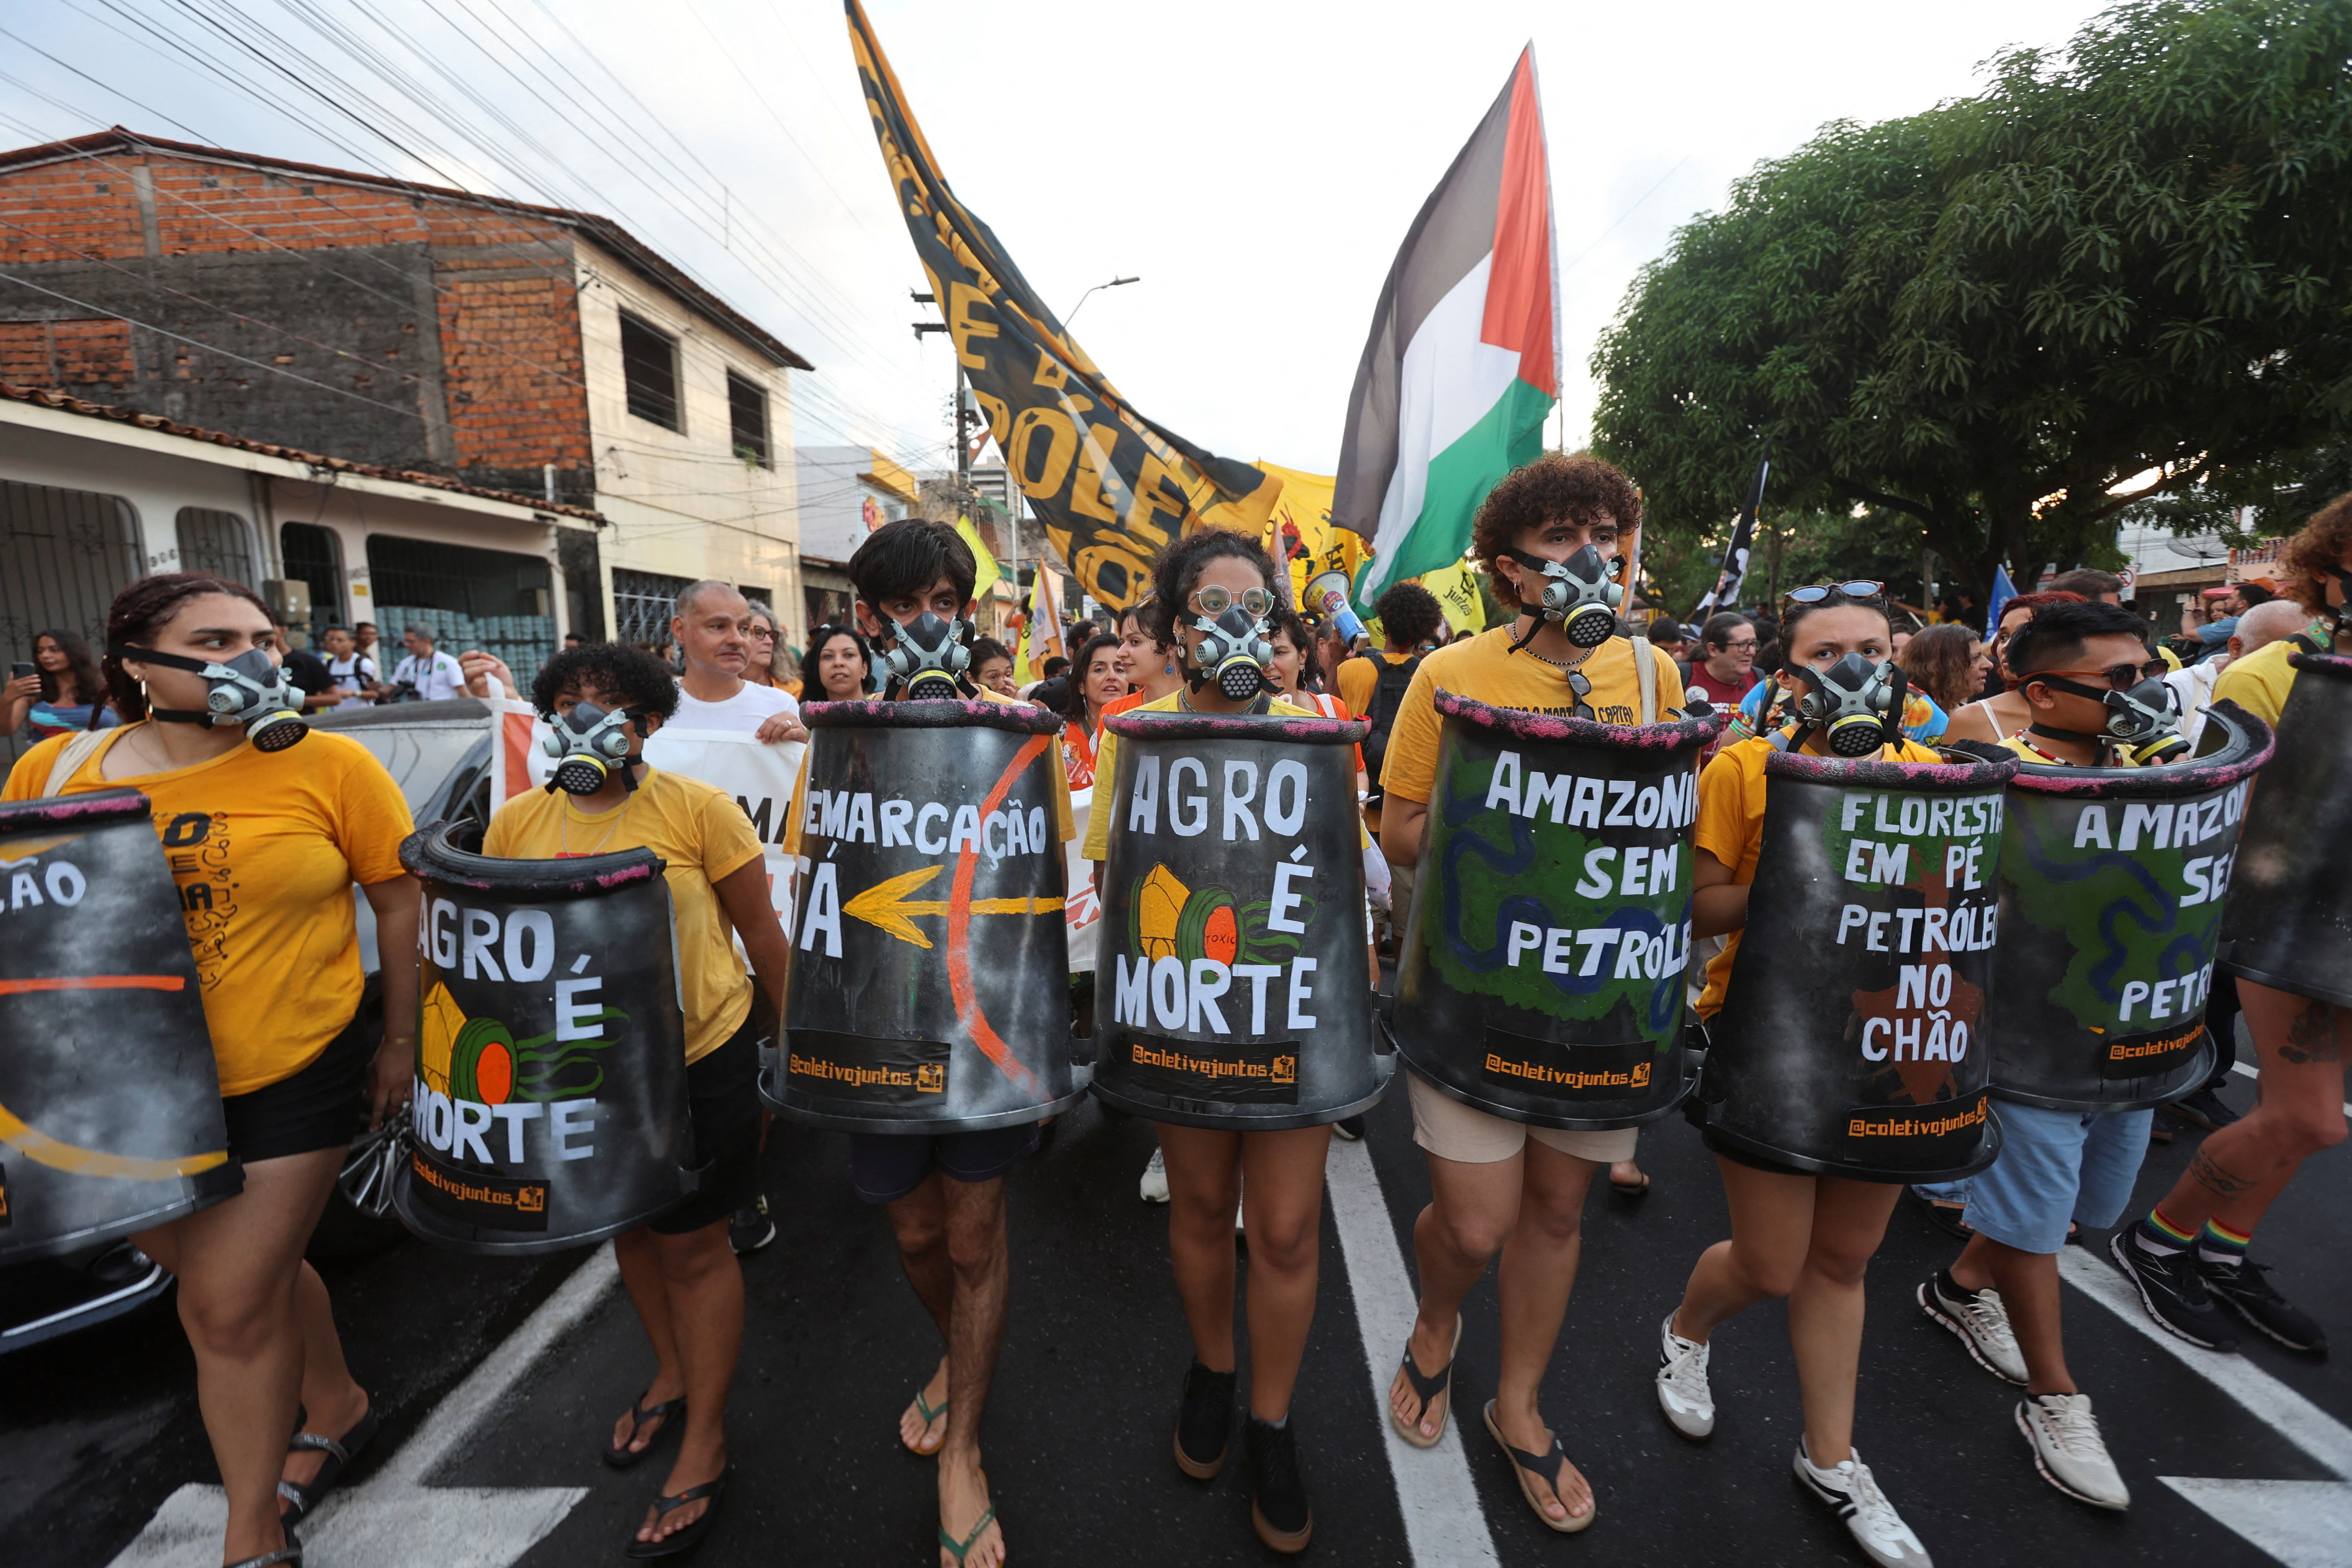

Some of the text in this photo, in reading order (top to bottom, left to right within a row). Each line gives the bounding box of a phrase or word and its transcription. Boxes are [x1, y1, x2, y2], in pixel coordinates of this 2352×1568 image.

[1443, 585, 1473, 616] juntos
[1129, 756, 1308, 841] AGRO
[801, 789, 1045, 870] EMARCAÇÃO
[0, 856, 86, 914] ÃO
[1268, 844, 1314, 934] É
[1574, 844, 1678, 900] SEM
[1845, 836, 1983, 891] EM PÉ
[1205, 933, 1235, 945] TOXIC
[555, 954, 604, 1041] É
[1115, 954, 1317, 1035] MORTE
[1896, 964, 1952, 1009] NO
[2119, 958, 2214, 1021] PETR
[1132, 1044, 1267, 1078] @coletivojuntos
[1862, 1010, 1968, 1063] CHÃO
[790, 1053, 912, 1087] @coletivojuntos
[1485, 1053, 1628, 1088] @coletivojuntos
[1849, 1111, 1975, 1137] @coletivojuntos
